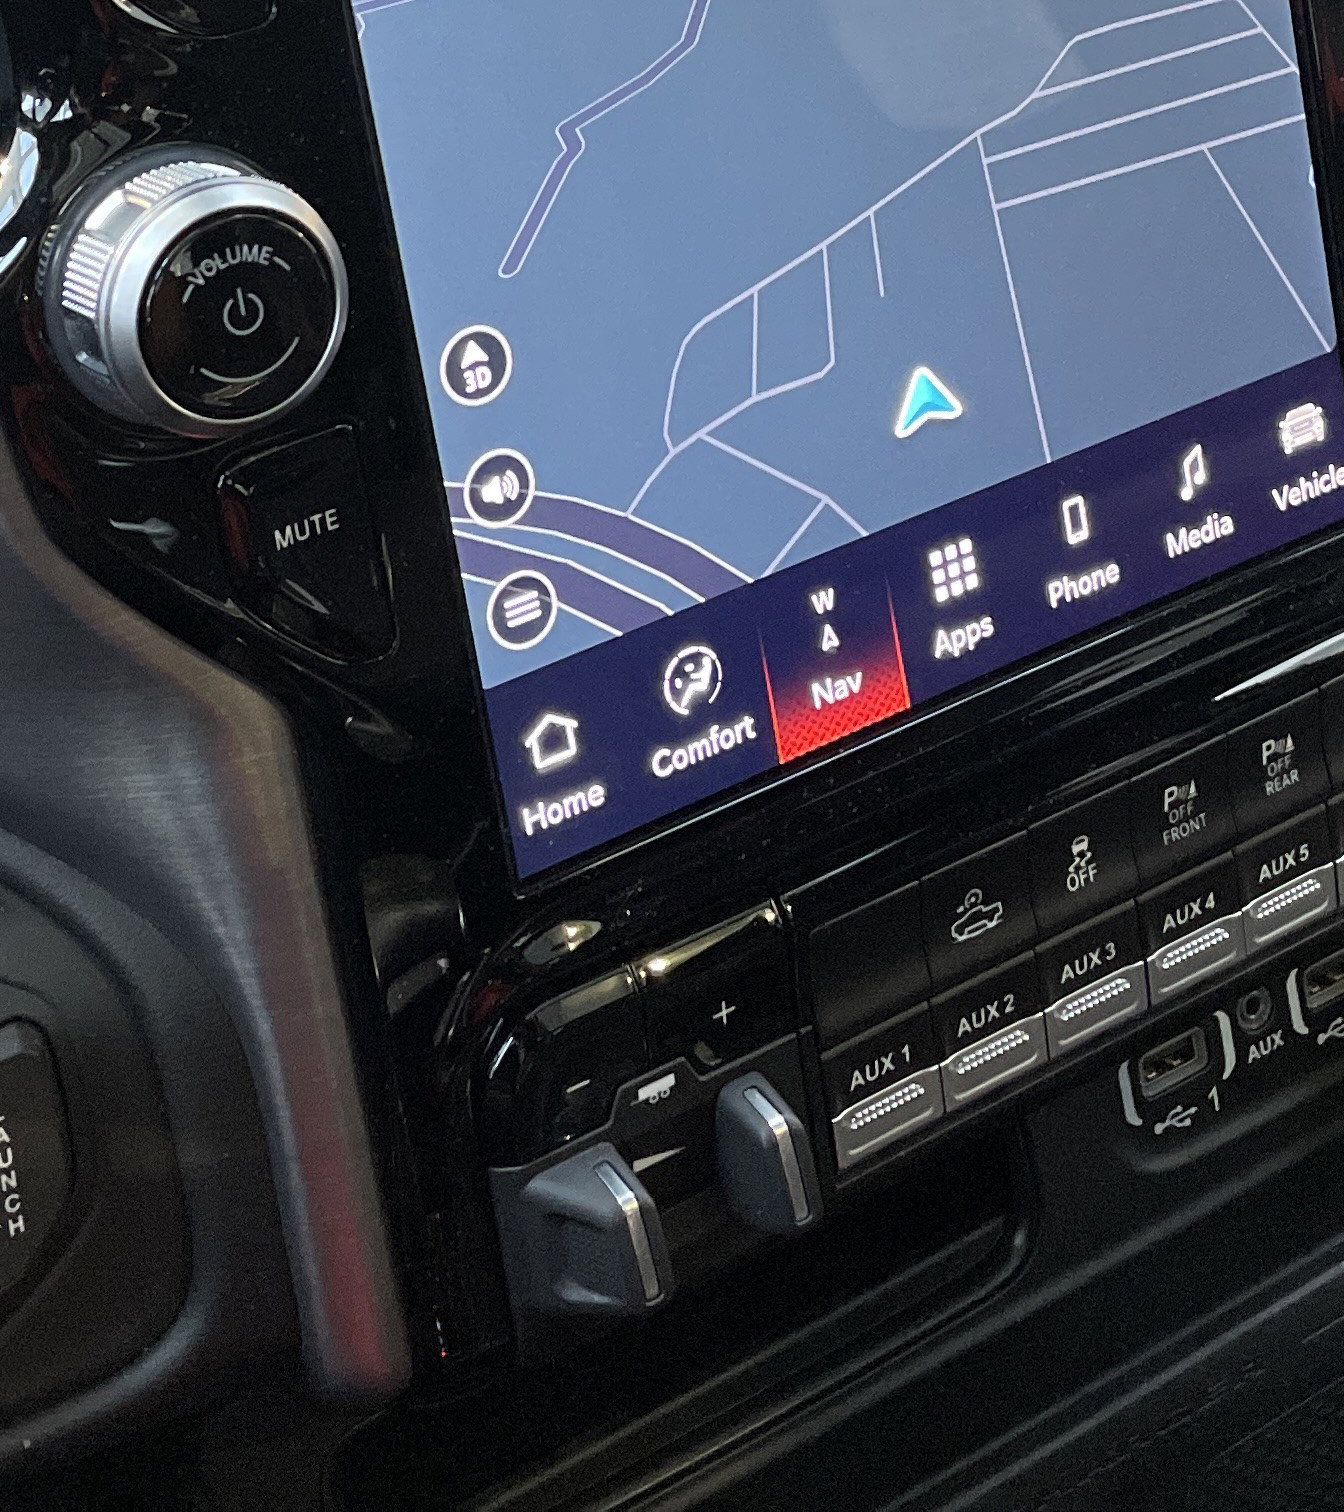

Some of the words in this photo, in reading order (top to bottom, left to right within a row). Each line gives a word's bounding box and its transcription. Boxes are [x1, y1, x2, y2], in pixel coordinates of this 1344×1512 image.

[190, 245, 273, 288] VOLUME
[464, 365, 490, 390] 3D
[274, 509, 341, 551] MUTE
[1166, 513, 1233, 557] Media
[811, 588, 834, 613] W
[1049, 563, 1120, 608] Phone
[933, 615, 994, 659] Apps
[811, 672, 862, 710] Nav
[652, 716, 756, 778] Comfort
[1267, 755, 1292, 777] OFF
[1265, 769, 1300, 796] REAR
[522, 784, 605, 835] Home
[1162, 813, 1207, 845] FRONT
[1169, 801, 1193, 824] OFF
[1066, 866, 1098, 892] OFF
[1259, 849, 1296, 882] AUX
[1297, 844, 1309, 862] 5
[1163, 899, 1201, 932] AUX
[1204, 892, 1216, 912] 4
[1060, 950, 1101, 983] AUX
[1105, 943, 1117, 962] 3
[956, 1002, 999, 1037] AUX
[1002, 994, 1015, 1015] 2
[850, 1054, 895, 1090] AUX
[901, 1045, 911, 1065] 1
[1247, 1031, 1285, 1065] AUX
[1207, 1087, 1220, 1111] 1
